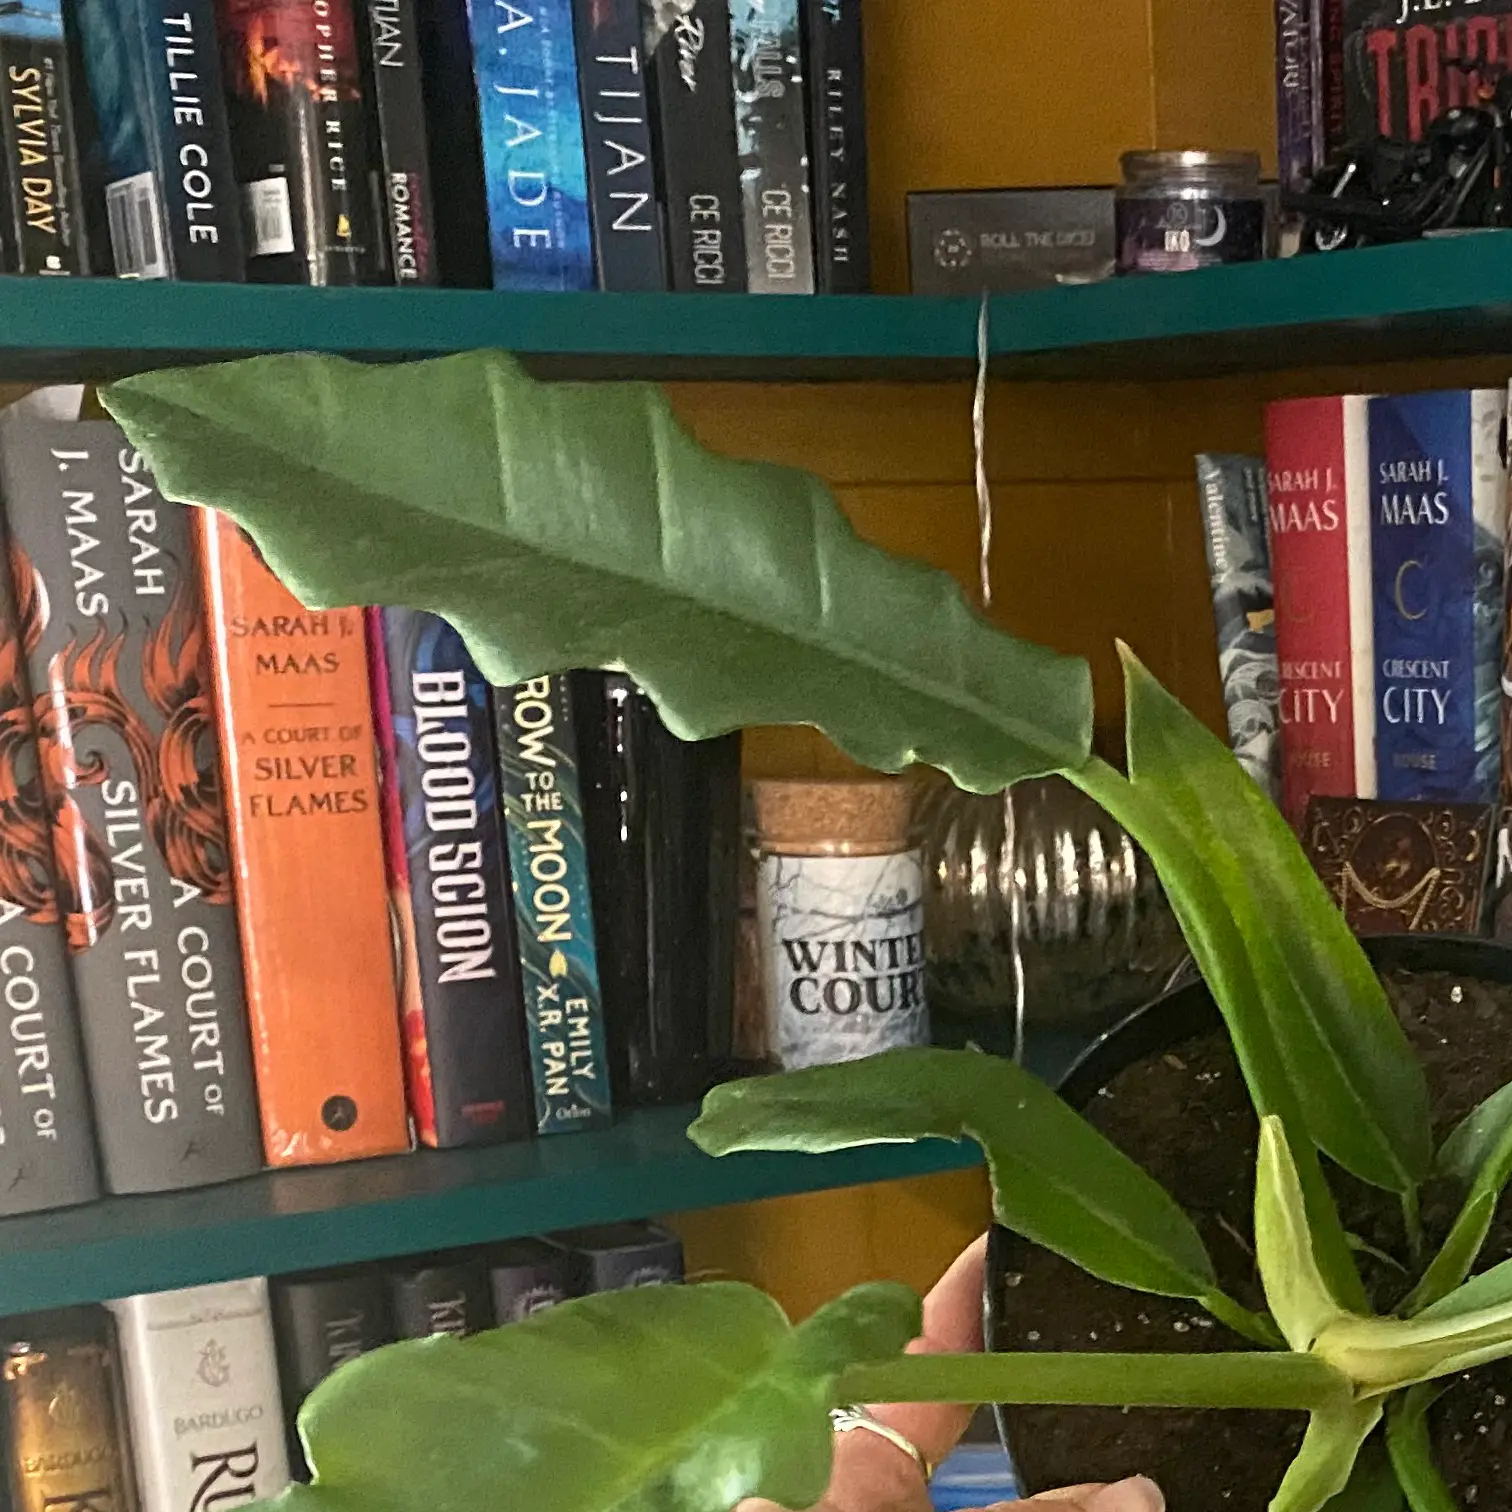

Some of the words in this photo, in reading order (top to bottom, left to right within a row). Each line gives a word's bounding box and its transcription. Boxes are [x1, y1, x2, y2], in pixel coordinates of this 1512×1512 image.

[163, 12, 204, 126] TILLIE
[9, 63, 48, 166] SYLVIA
[595, 45, 653, 232] TIJAN
[826, 68, 846, 163] RILEY
[179, 143, 219, 244] COLE
[493, 84, 552, 250] JADE
[20, 176, 57, 234] DAY
[391, 172, 420, 280] ROMANCE
[830, 183, 850, 263] NASH
[692, 229, 726, 285] RICCI
[765, 224, 797, 278] RICCI
[979, 233, 1020, 249] ROLL
[1024, 232, 1054, 248] THE
[1267, 468, 1318, 494] SARAH
[1379, 460, 1432, 485] SARAH
[118, 448, 166, 596] SARAH
[1270, 499, 1340, 533] MAAS
[1379, 491, 1450, 526] MAAS
[61, 490, 109, 617] MAAS
[231, 612, 329, 639] SARAH
[256, 652, 341, 676] MAAS
[1280, 660, 1343, 679] RESCENT
[1382, 659, 1451, 679] CRESCENT
[1278, 688, 1345, 724] CITY
[1382, 687, 1452, 725] CITY
[264, 726, 332, 745] COURT
[412, 669, 479, 833] BLOOD
[254, 754, 358, 781] SILVER
[526, 771, 554, 790] TO
[249, 789, 370, 819] FLAMES
[523, 791, 564, 814] THE
[100, 779, 153, 932] SILVER
[526, 818, 573, 944] MOON
[170, 877, 202, 908] A
[428, 842, 499, 985] SCION
[176, 926, 226, 1077] COURT
[0, 946, 56, 1099] COURT
[33, 1107, 57, 1140] OF
[123, 948, 180, 1125] FLAMES
[565, 996, 597, 1081] EMILY
[541, 1039, 570, 1096] PAN
[204, 1083, 225, 1117] OF
[173, 1403, 265, 1435] BARDUGO
